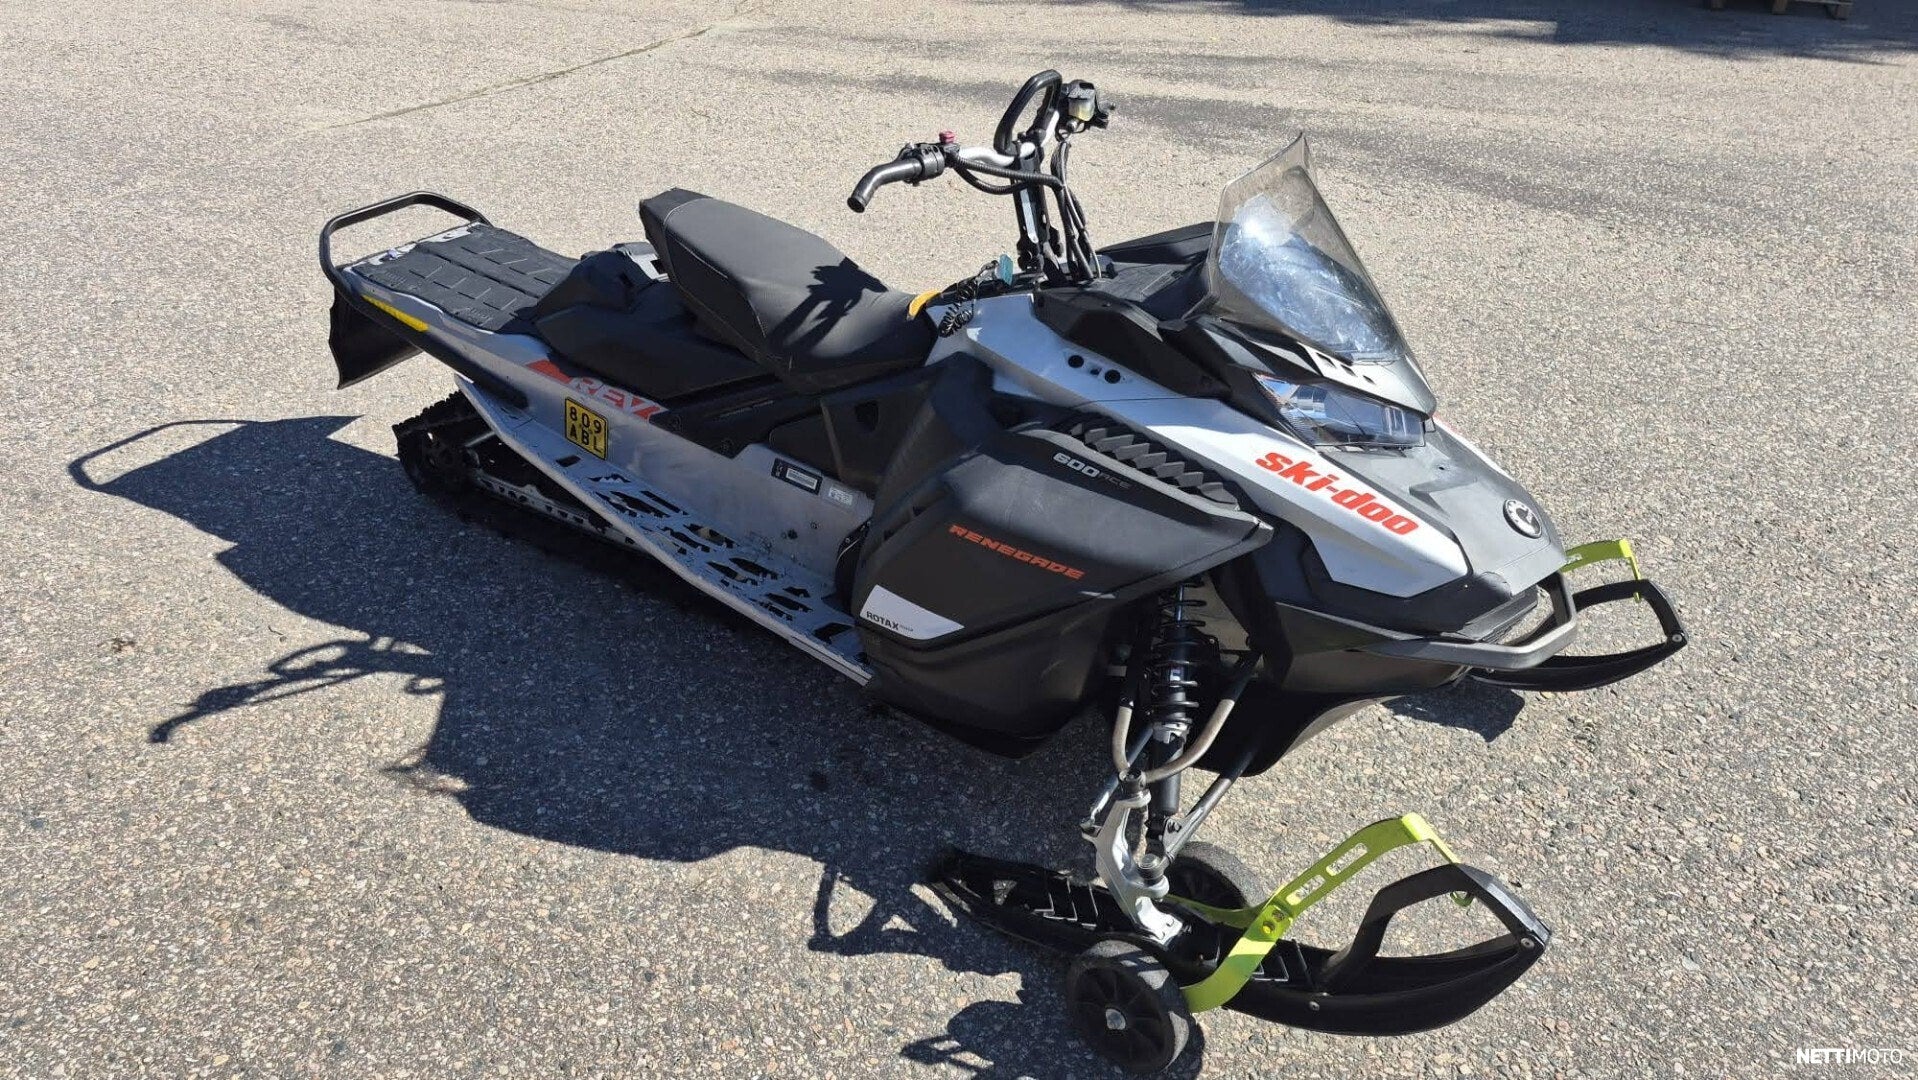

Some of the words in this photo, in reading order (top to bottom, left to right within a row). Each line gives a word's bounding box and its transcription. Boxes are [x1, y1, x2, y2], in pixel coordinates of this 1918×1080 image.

[569, 406, 602, 434] 809
[569, 423, 603, 454] ABL
[1053, 452, 1100, 478] 600
[1255, 452, 1419, 535] ski-doo
[949, 524, 1086, 580] RENEGADE
[866, 611, 899, 631] ROTAX
